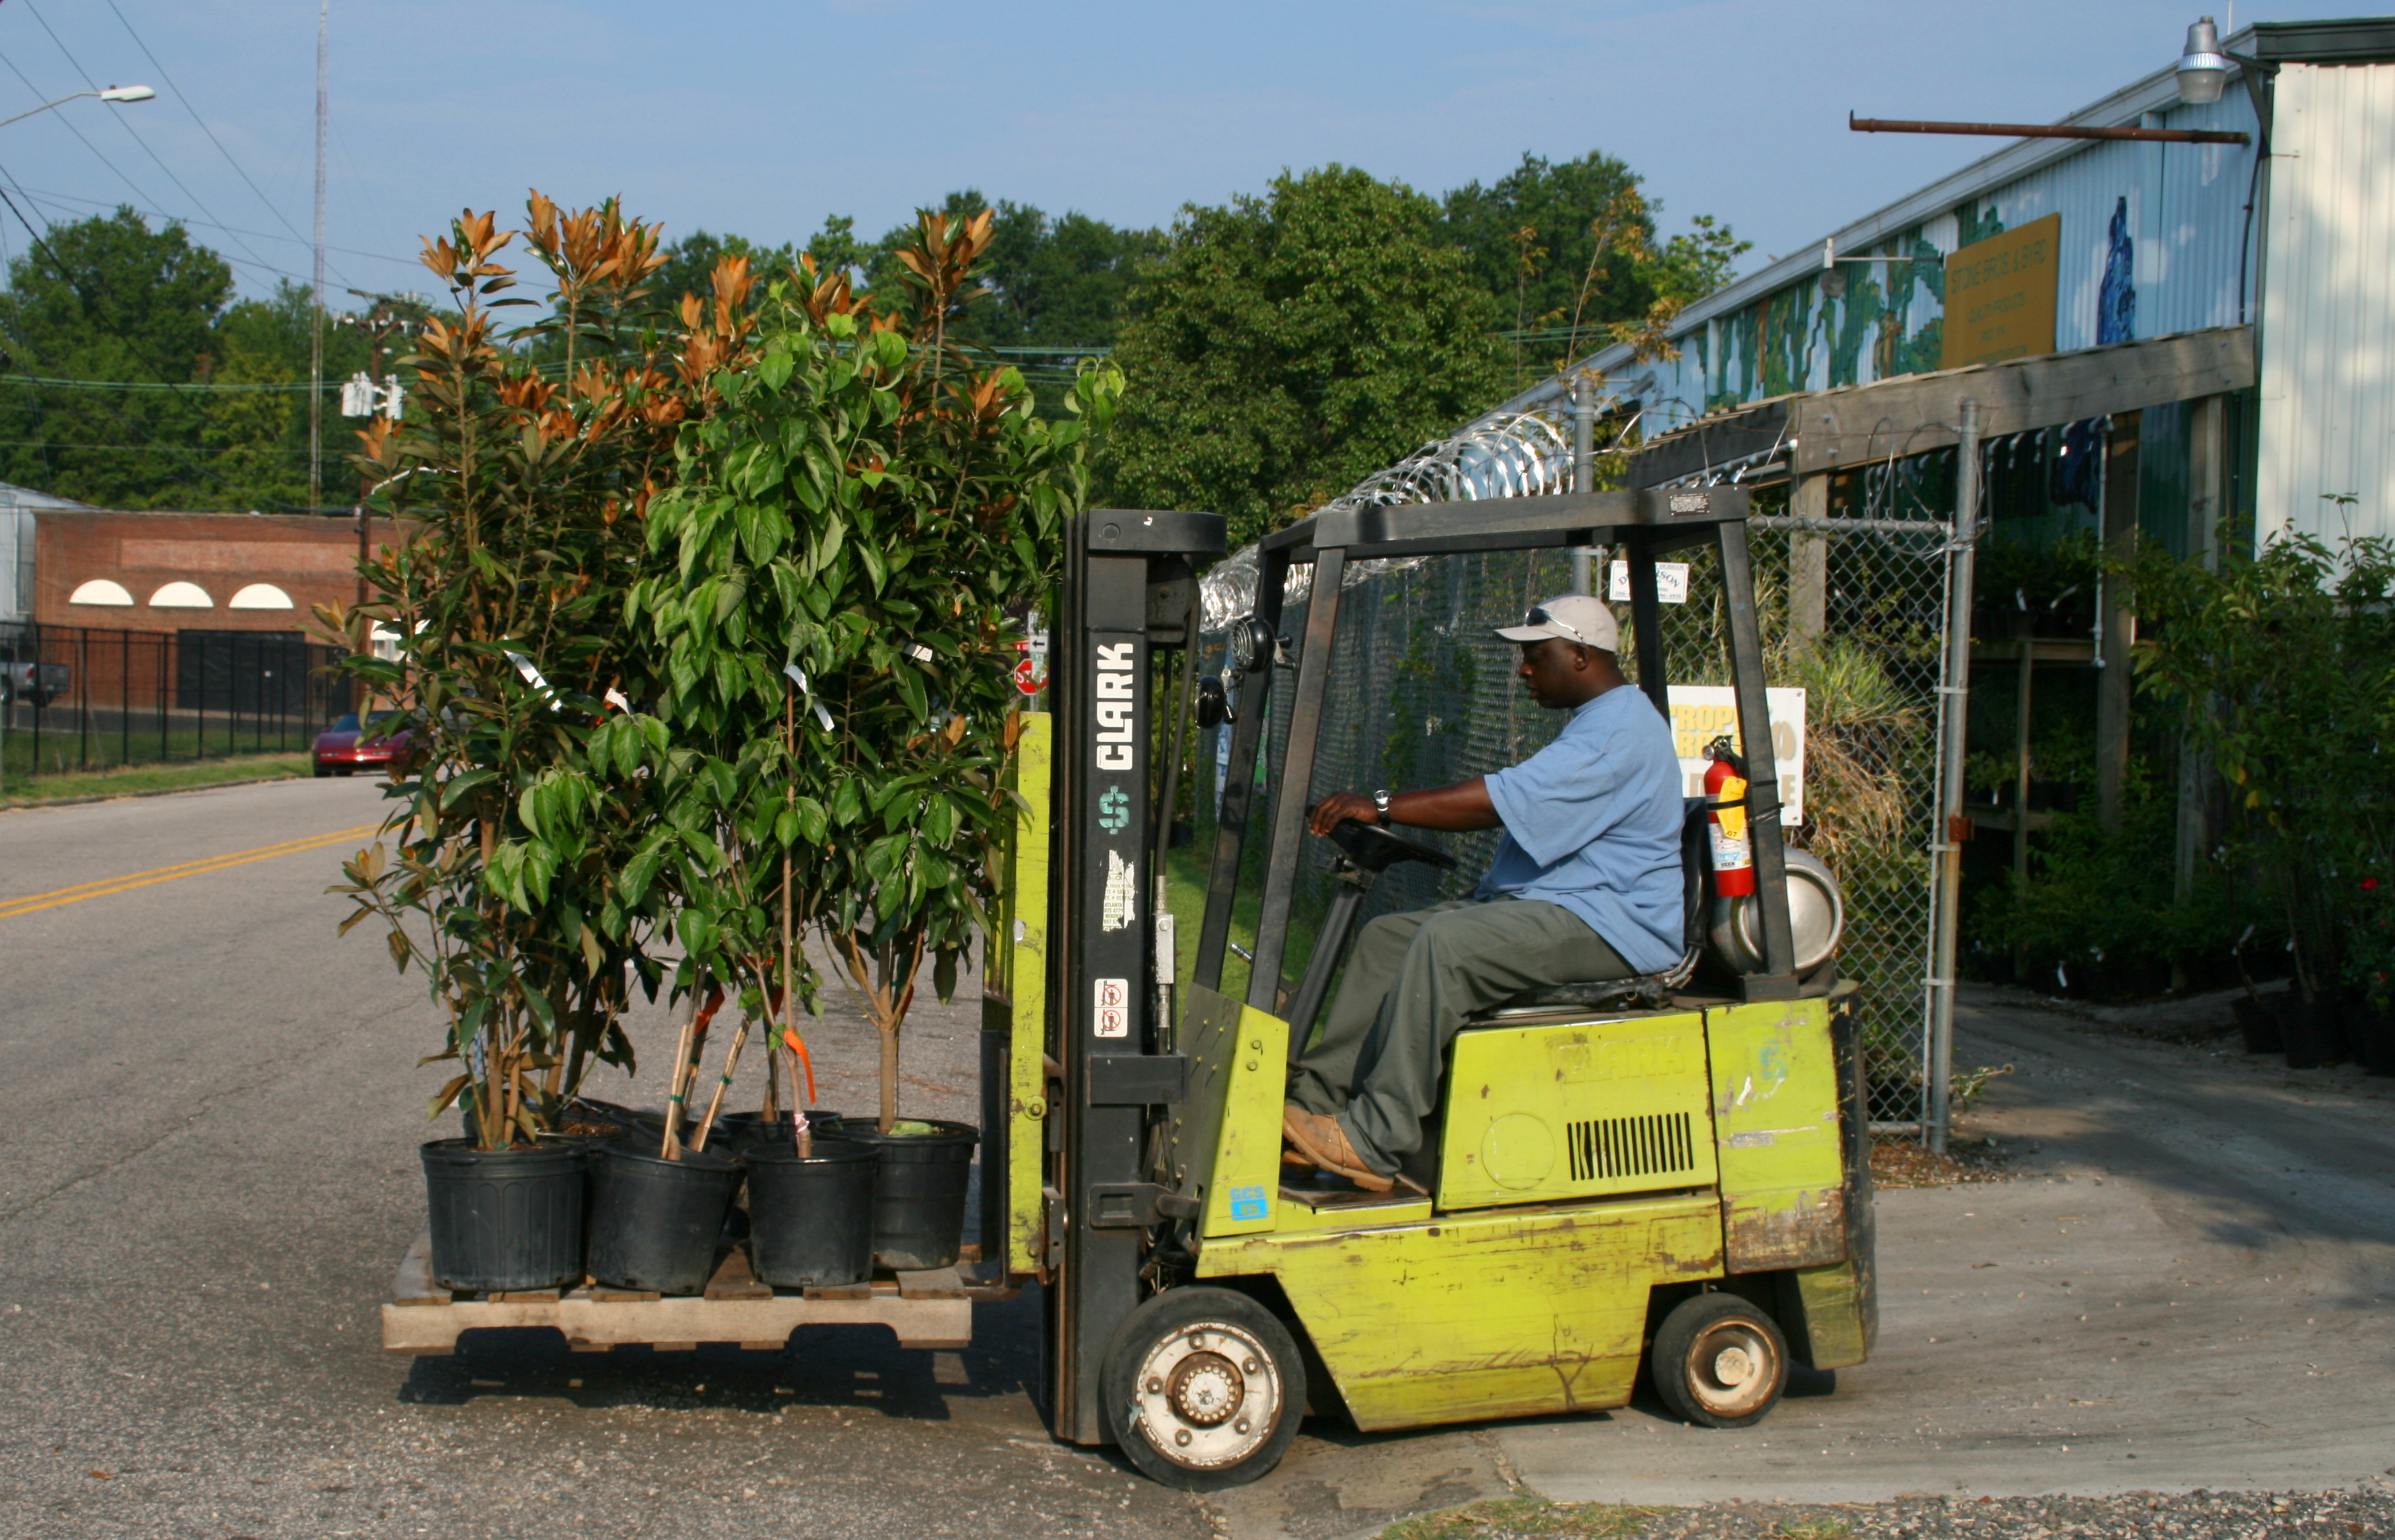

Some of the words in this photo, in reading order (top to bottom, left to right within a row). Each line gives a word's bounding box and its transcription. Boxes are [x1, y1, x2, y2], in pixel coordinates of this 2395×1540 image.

[1952, 261, 1982, 293] STONE
[1017, 669, 1047, 684] STP
[1097, 643, 1134, 770] CLARK
[1557, 1035, 1685, 1085] CLARK
[1229, 1185, 1265, 1200] GCS
[1239, 1202, 1259, 1216] 15
